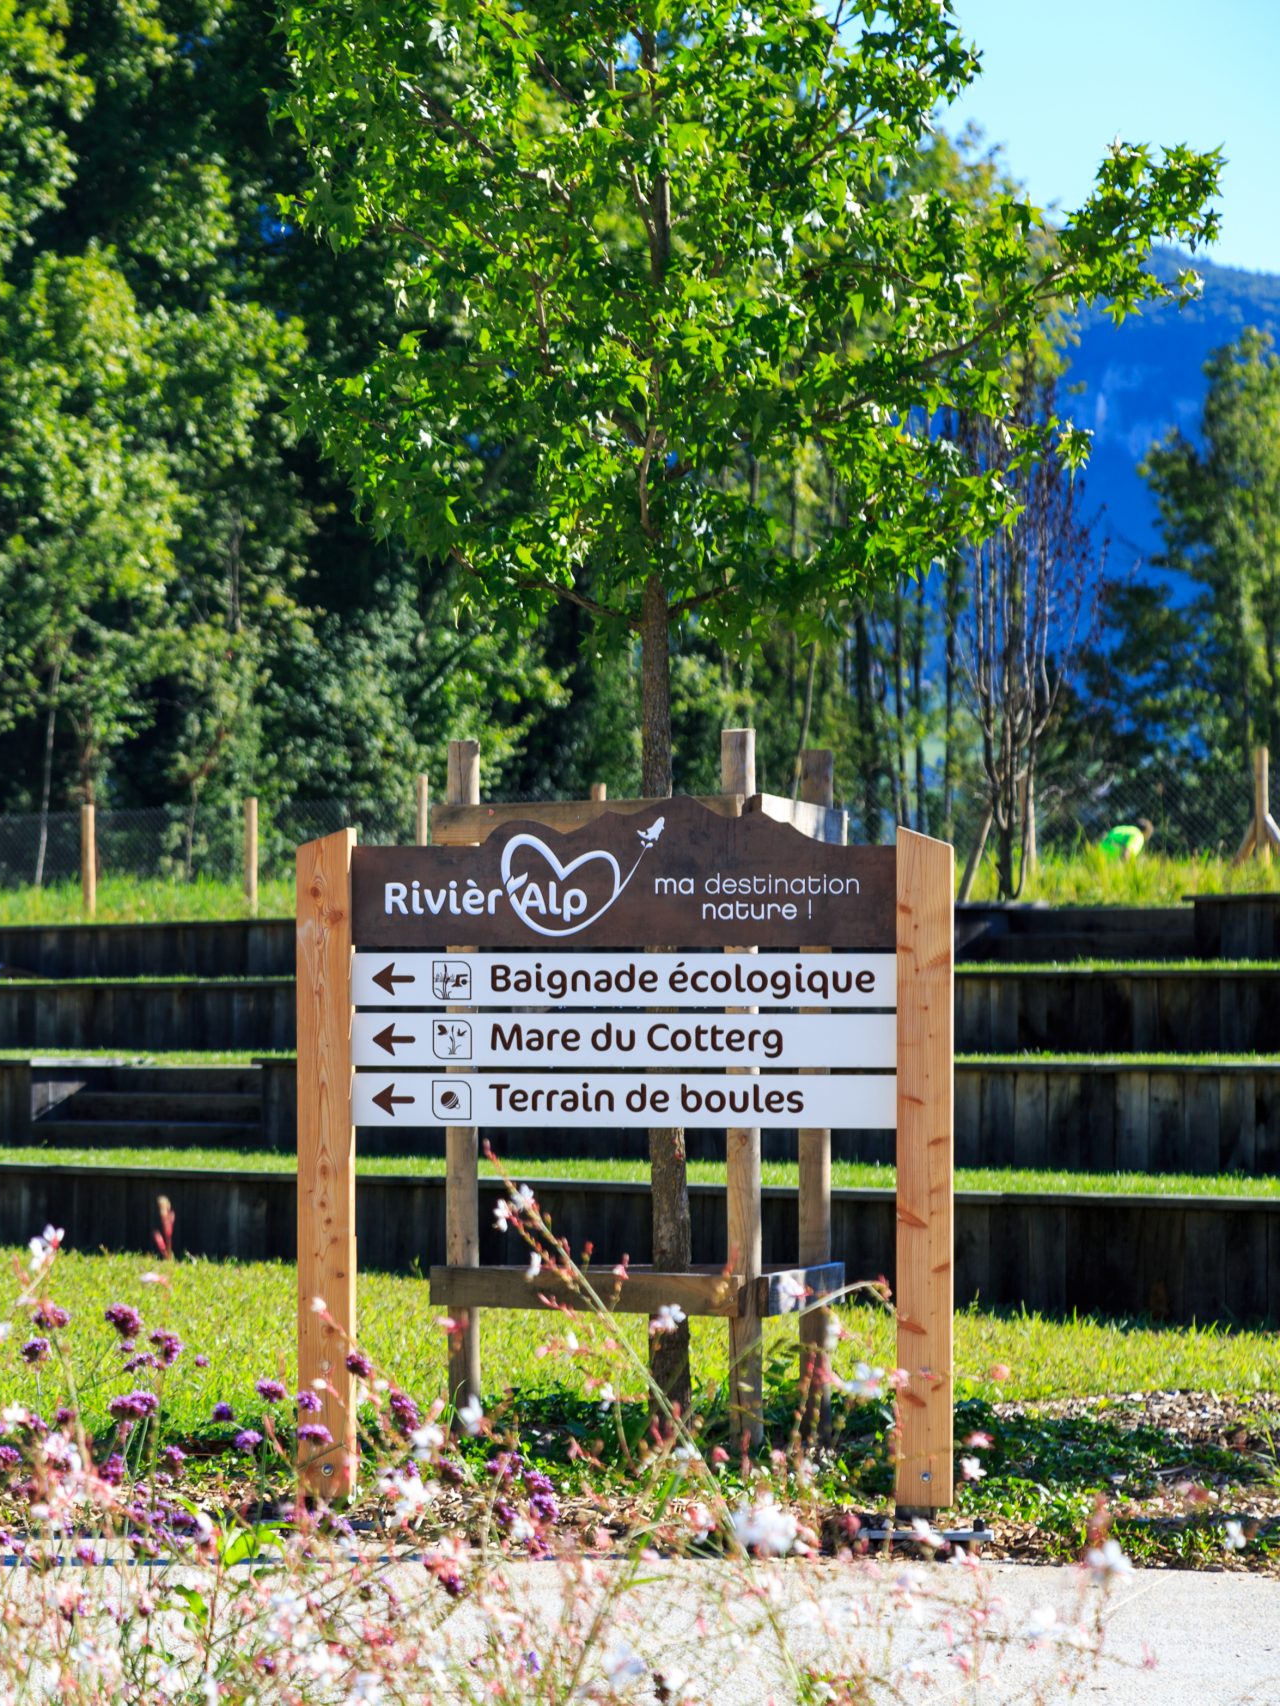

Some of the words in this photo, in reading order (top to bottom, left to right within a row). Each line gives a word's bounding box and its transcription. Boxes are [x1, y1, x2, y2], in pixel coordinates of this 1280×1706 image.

[654, 877, 695, 895] ma
[704, 872, 860, 895] destination
[702, 900, 798, 920] nature
[490, 962, 659, 999] Baignade
[668, 961, 876, 1000] écologique
[490, 1023, 581, 1052] Mare
[590, 1022, 636, 1052] du
[646, 1023, 783, 1059] Cotterg
[488, 1082, 615, 1113] Terrain
[625, 1083, 670, 1113] de
[680, 1083, 804, 1114] boules
